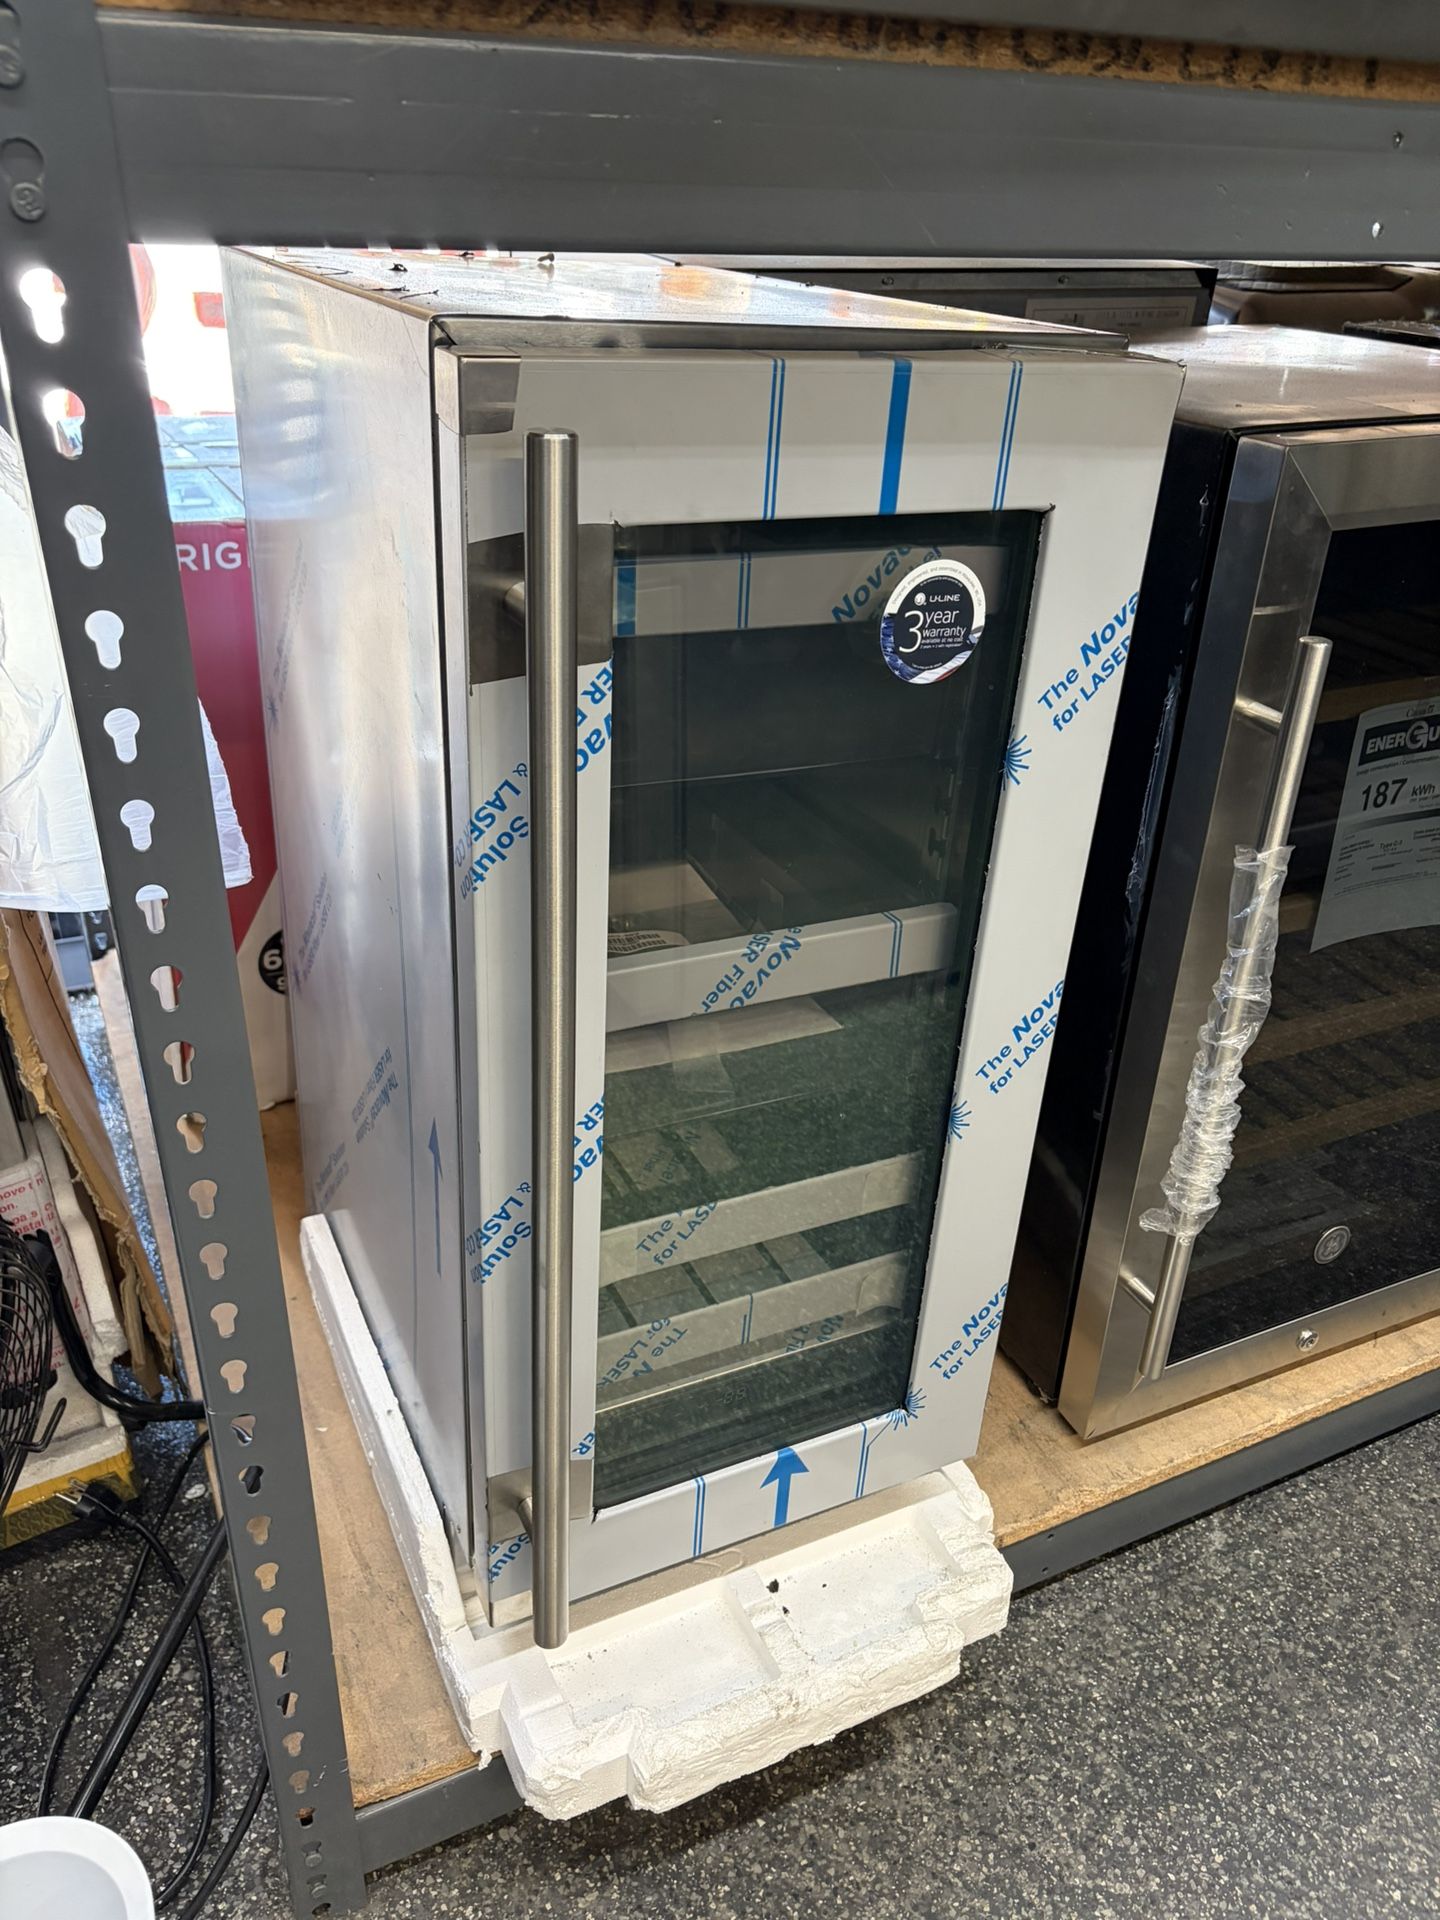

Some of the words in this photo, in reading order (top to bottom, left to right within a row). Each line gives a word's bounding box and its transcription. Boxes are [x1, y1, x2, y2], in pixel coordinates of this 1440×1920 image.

[176, 541, 250, 571] RIG
[929, 594, 961, 603] U-LINE
[899, 610, 924, 653] 3
[922, 625, 967, 638] warranty
[925, 610, 960, 628] year
[1038, 668, 1080, 710] The
[1053, 699, 1080, 732] for
[1362, 778, 1408, 811] 187
[1411, 784, 1436, 797] kWh
[976, 1045, 1012, 1079] The
[989, 1067, 1013, 1094] for
[636, 1219, 674, 1253] The
[653, 1240, 680, 1265] for
[652, 1328, 688, 1358] The
[929, 1340, 962, 1369] The
[943, 1357, 964, 1380] for
